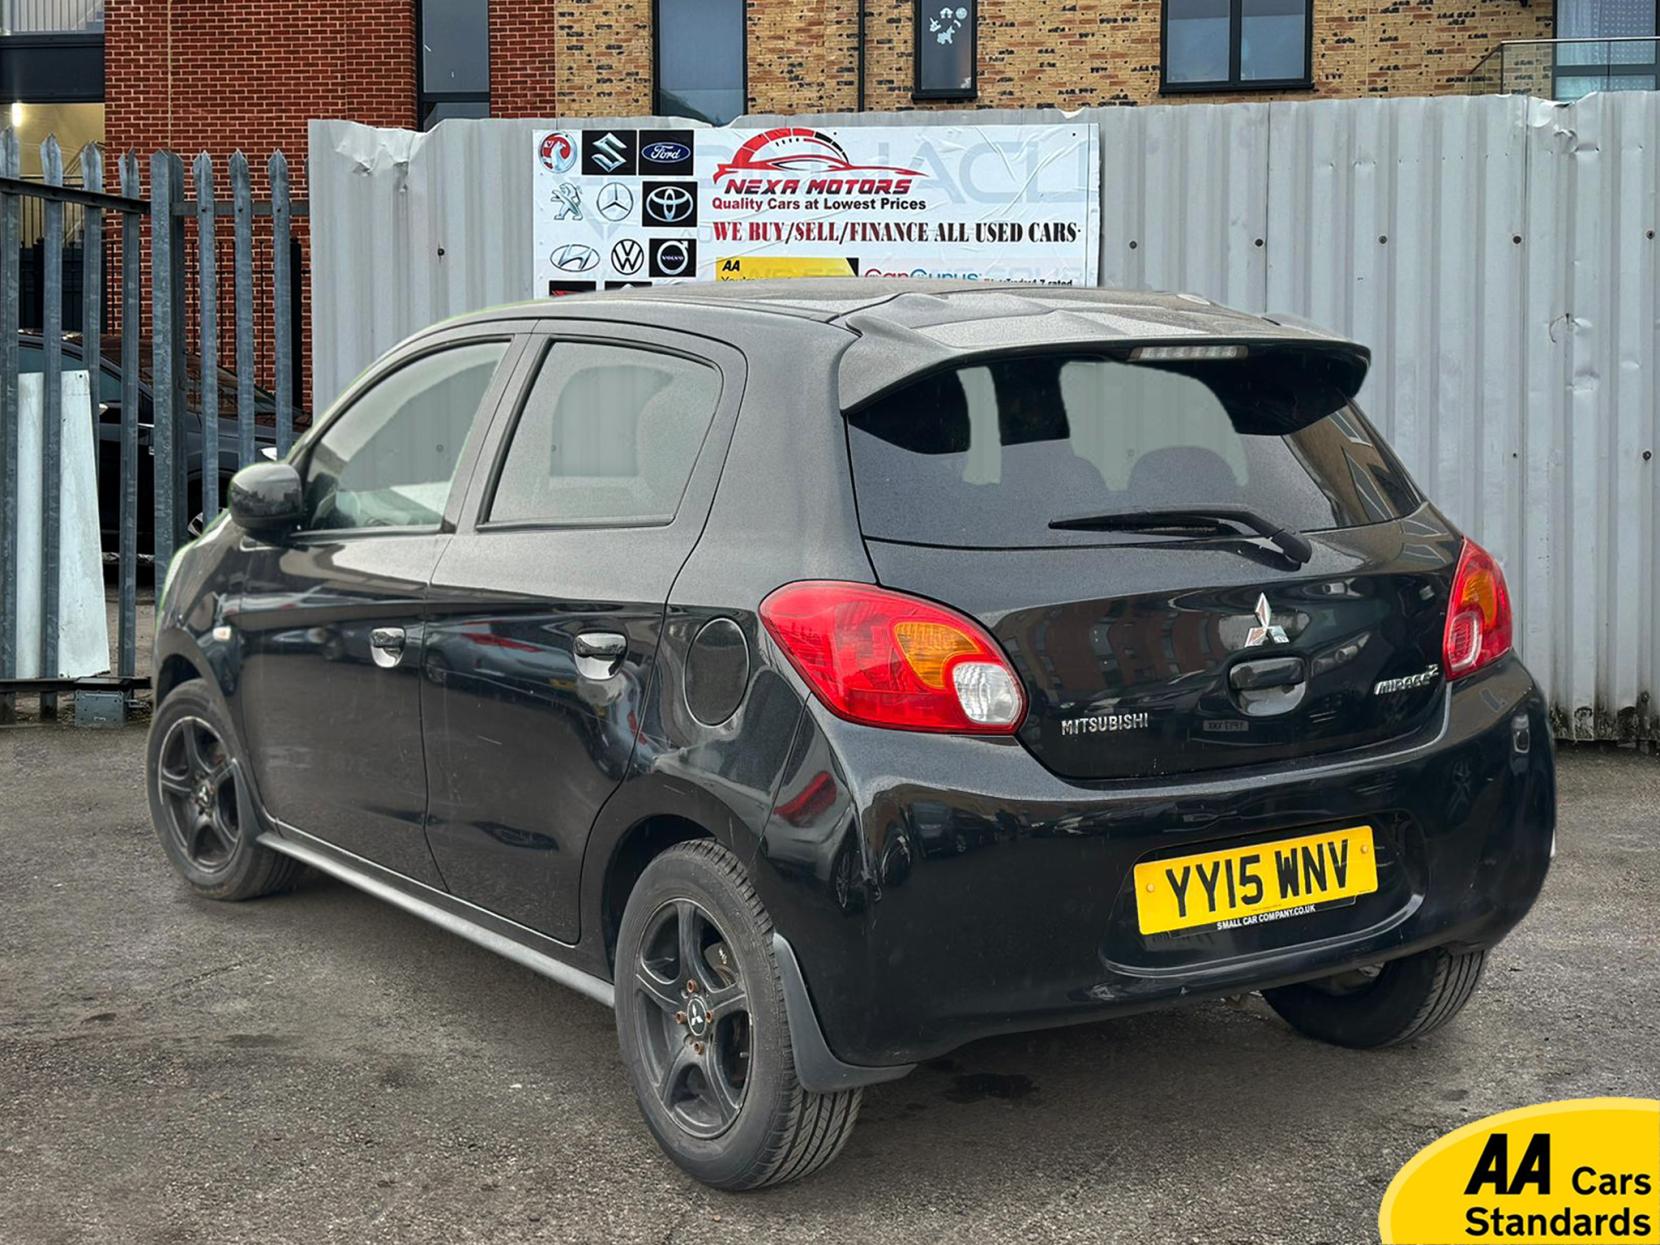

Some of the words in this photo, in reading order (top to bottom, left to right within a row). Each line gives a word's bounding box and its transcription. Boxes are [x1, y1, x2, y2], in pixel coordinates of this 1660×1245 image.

[650, 144, 680, 160] Ford
[724, 179, 800, 195] NEXA
[806, 179, 912, 195] MOTORS
[712, 198, 763, 212] Quality
[767, 199, 800, 210] Cars
[805, 199, 820, 210] at
[824, 198, 876, 210] Lowest
[880, 198, 926, 210] Prices
[712, 221, 742, 242] WE
[934, 222, 970, 242] ALL
[975, 222, 1023, 243] USED
[722, 260, 741, 272] AA
[1061, 712, 1149, 736] MITSUBISHI
[1165, 854, 1264, 918] YY15
[1274, 838, 1349, 899] WNV
[1216, 918, 1242, 931] SMALL
[1243, 915, 1258, 926] CAR
[1259, 904, 1316, 922] COMPANY.CO.UK
